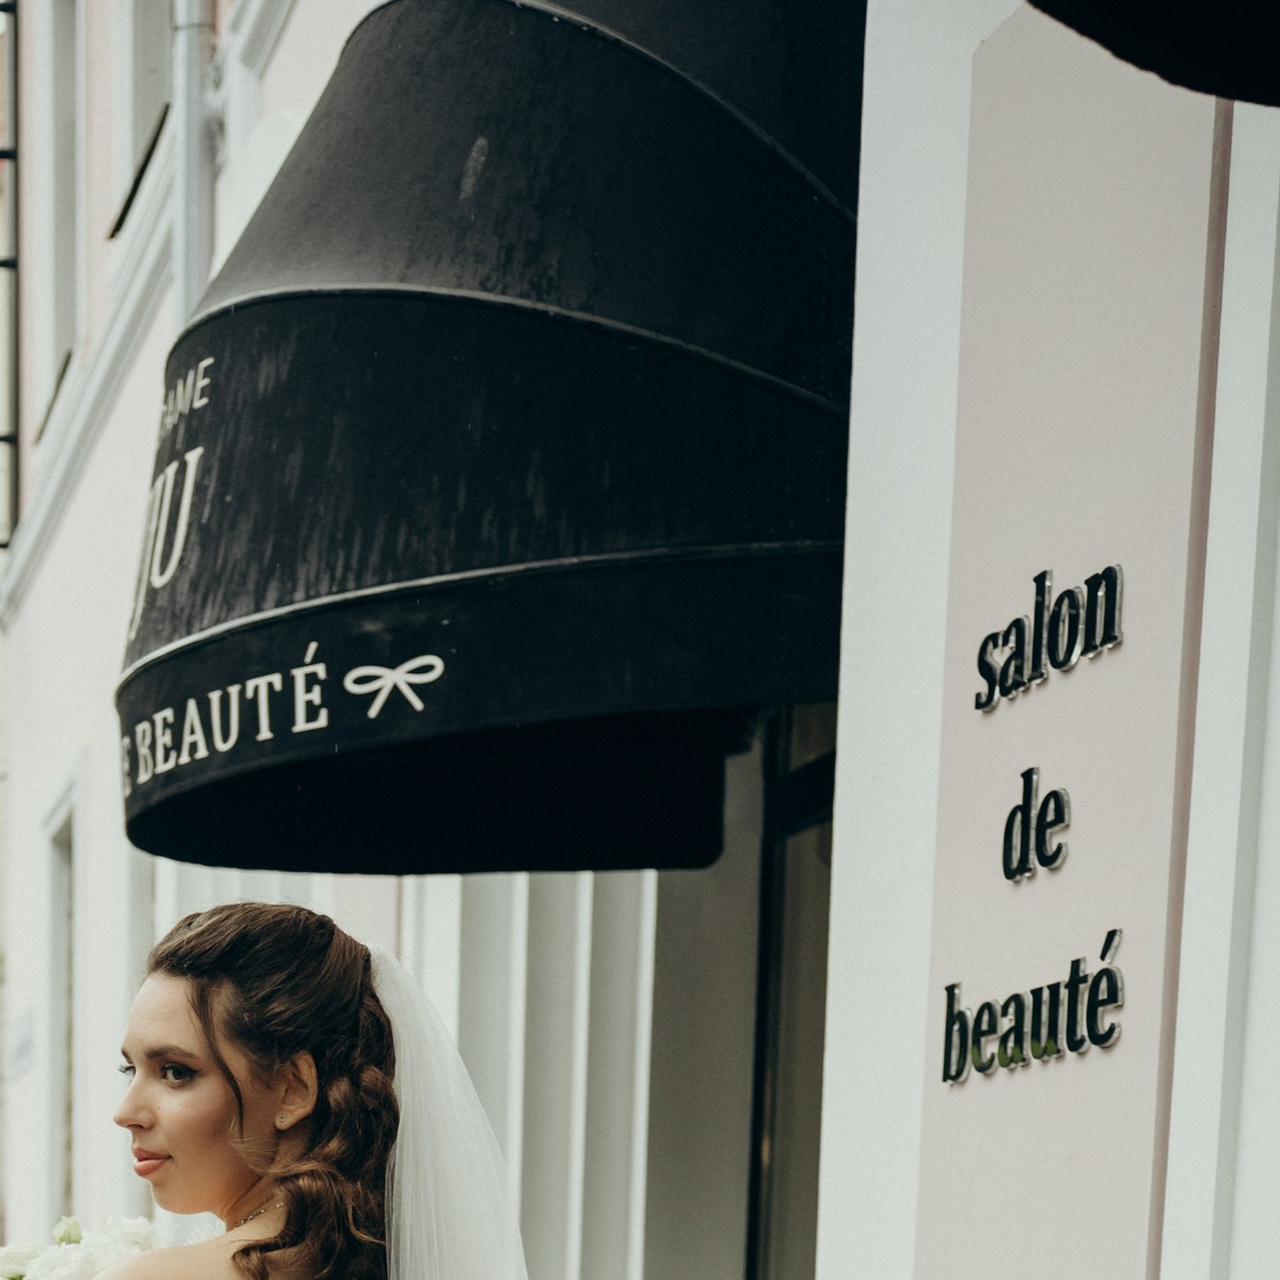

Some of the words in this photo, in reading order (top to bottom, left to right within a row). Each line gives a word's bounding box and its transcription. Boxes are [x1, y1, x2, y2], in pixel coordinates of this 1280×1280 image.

[162, 356, 216, 430] AME
[974, 563, 1124, 713] salon
[134, 640, 329, 785] BEAUTÉ
[1001, 766, 1071, 882] de
[941, 928, 1125, 1087] beauté
